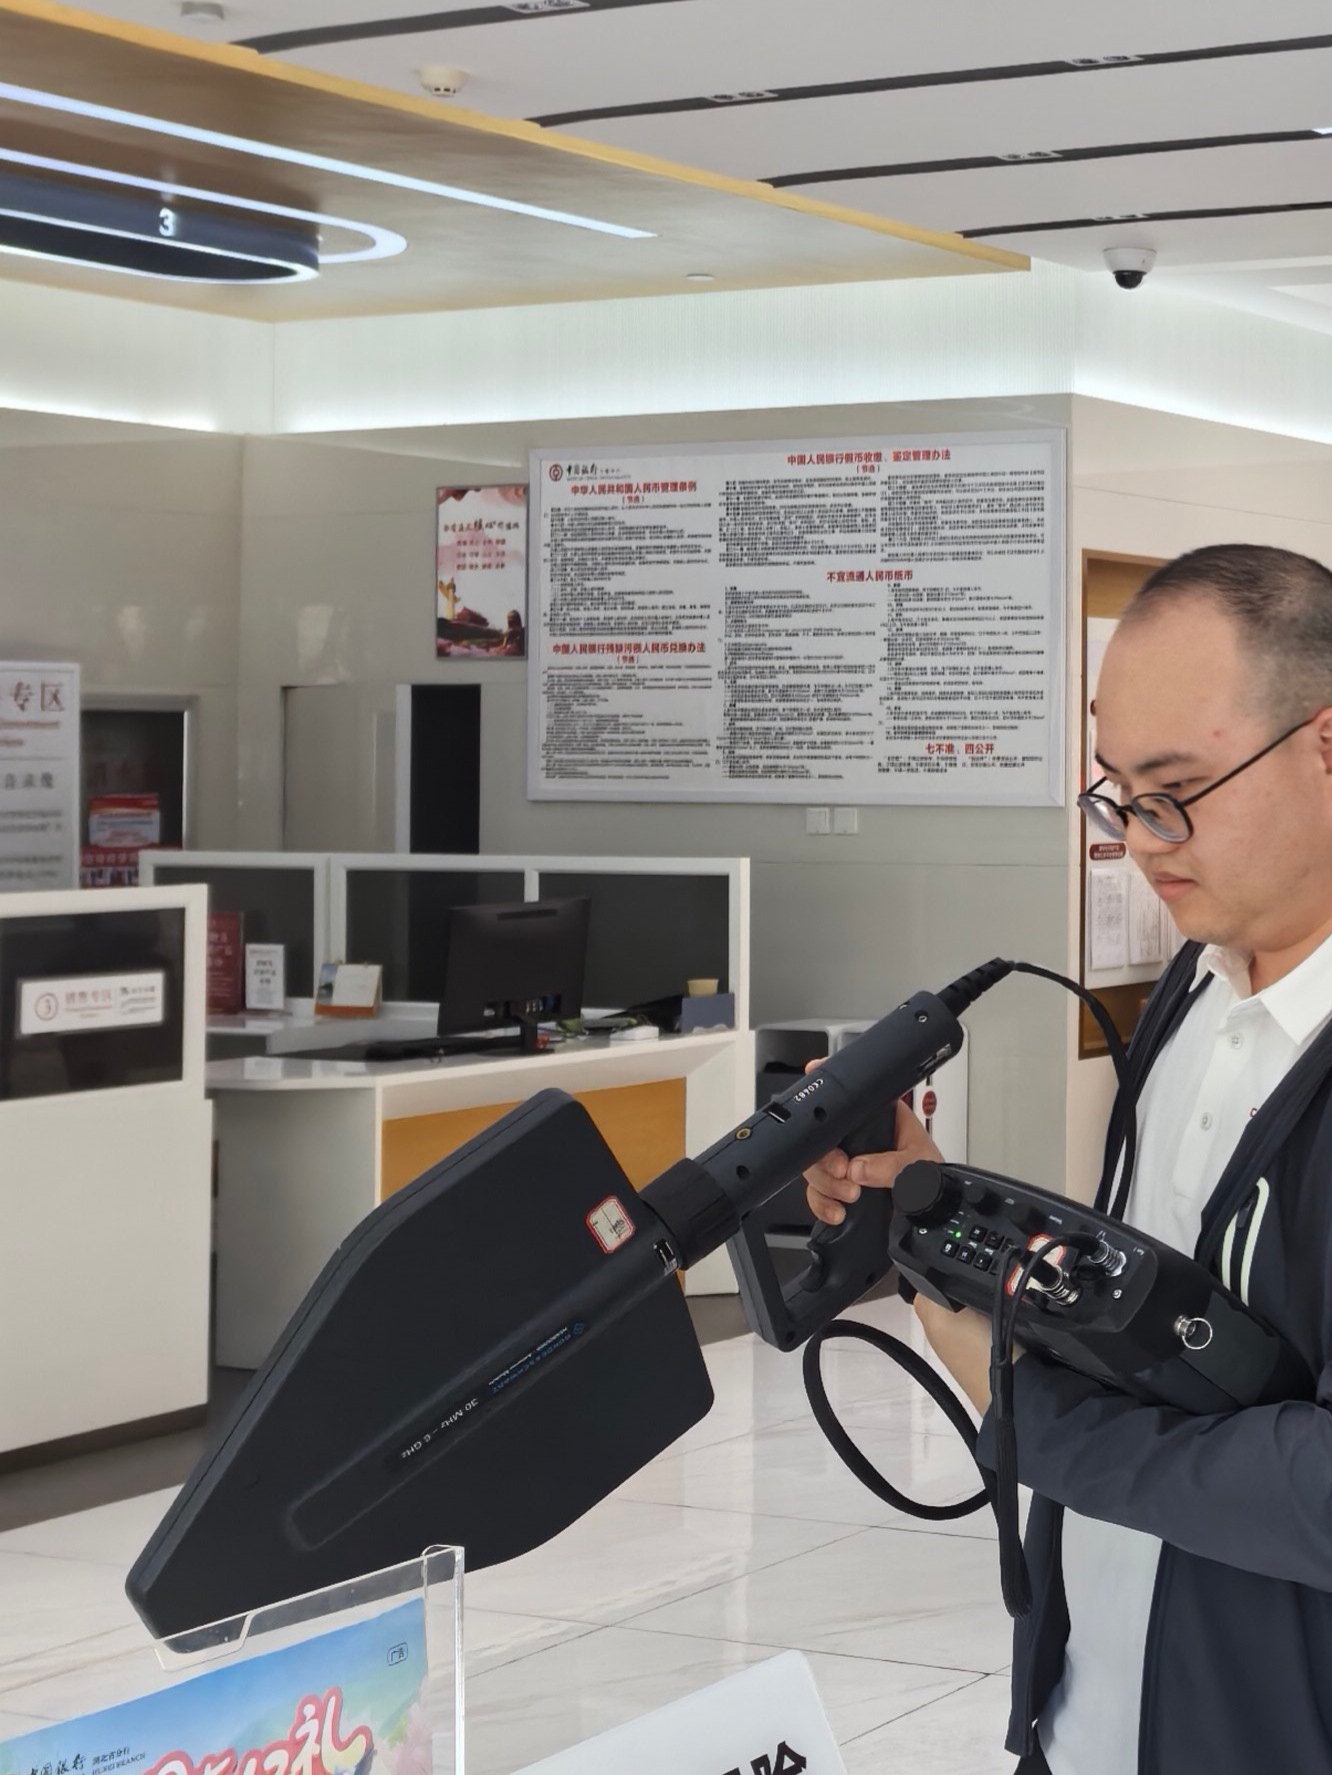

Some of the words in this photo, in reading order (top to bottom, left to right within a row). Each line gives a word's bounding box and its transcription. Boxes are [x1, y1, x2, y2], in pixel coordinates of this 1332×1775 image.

[159, 208, 177, 236] 3
[465, 1398, 478, 1411] 30
[441, 1410, 463, 1429] MHz
[423, 1433, 431, 1442] 6
[401, 1441, 422, 1458] GHz
